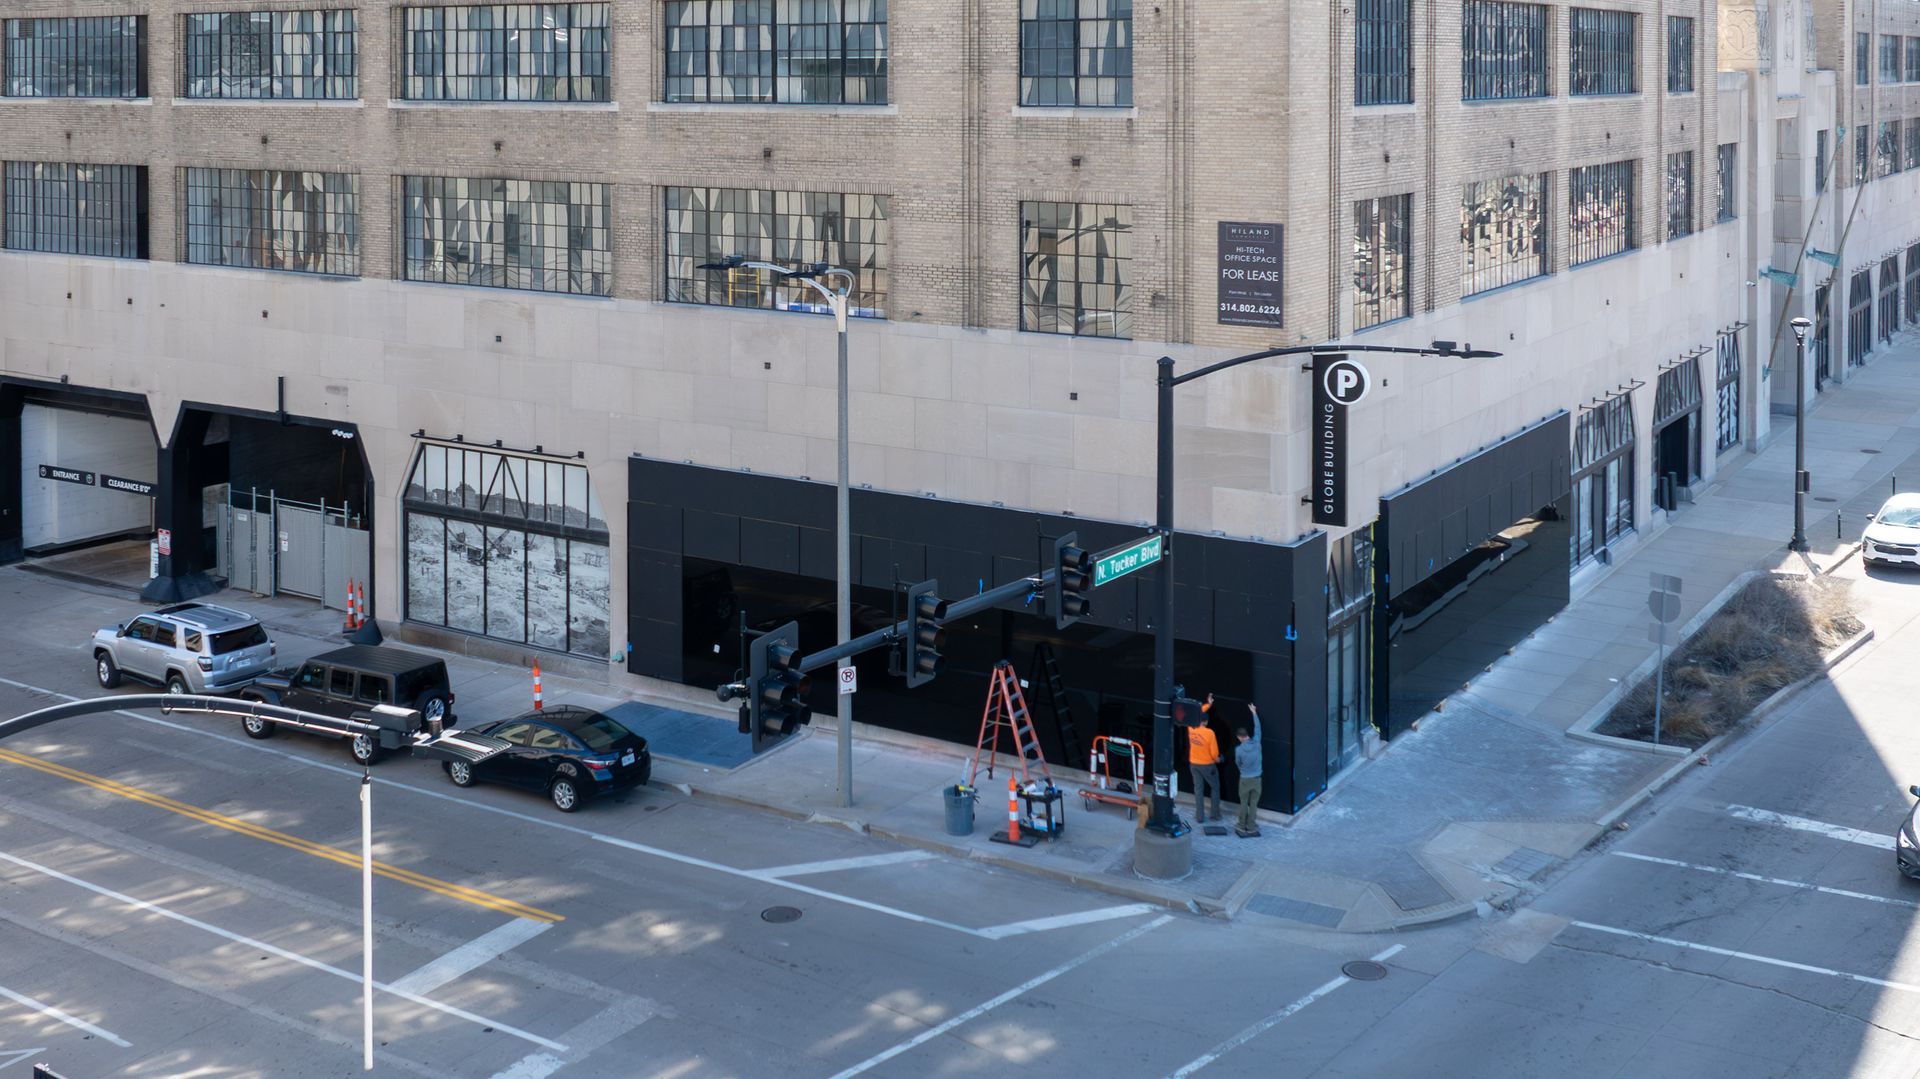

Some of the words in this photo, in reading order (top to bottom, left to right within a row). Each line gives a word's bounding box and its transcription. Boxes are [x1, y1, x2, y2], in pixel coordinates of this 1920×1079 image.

[1236, 246, 1265, 254] HI-TECH
[1224, 254, 1250, 263] OFFICE
[1252, 255, 1277, 264] SPACE
[1222, 268, 1244, 280] FOR
[1247, 270, 1279, 282] LEASE
[1220, 303, 1280, 314] 314.802.6226
[1337, 368, 1358, 398] P
[1324, 403, 1334, 467] BUILDING
[53, 470, 80, 480] ENTRANCE
[108, 479, 139, 491] CLEARANCE
[1324, 471, 1334, 514] GLOBE
[1098, 564, 1106, 579] N.
[1110, 554, 1138, 574] Tucker
[1141, 543, 1159, 561] Blvd
